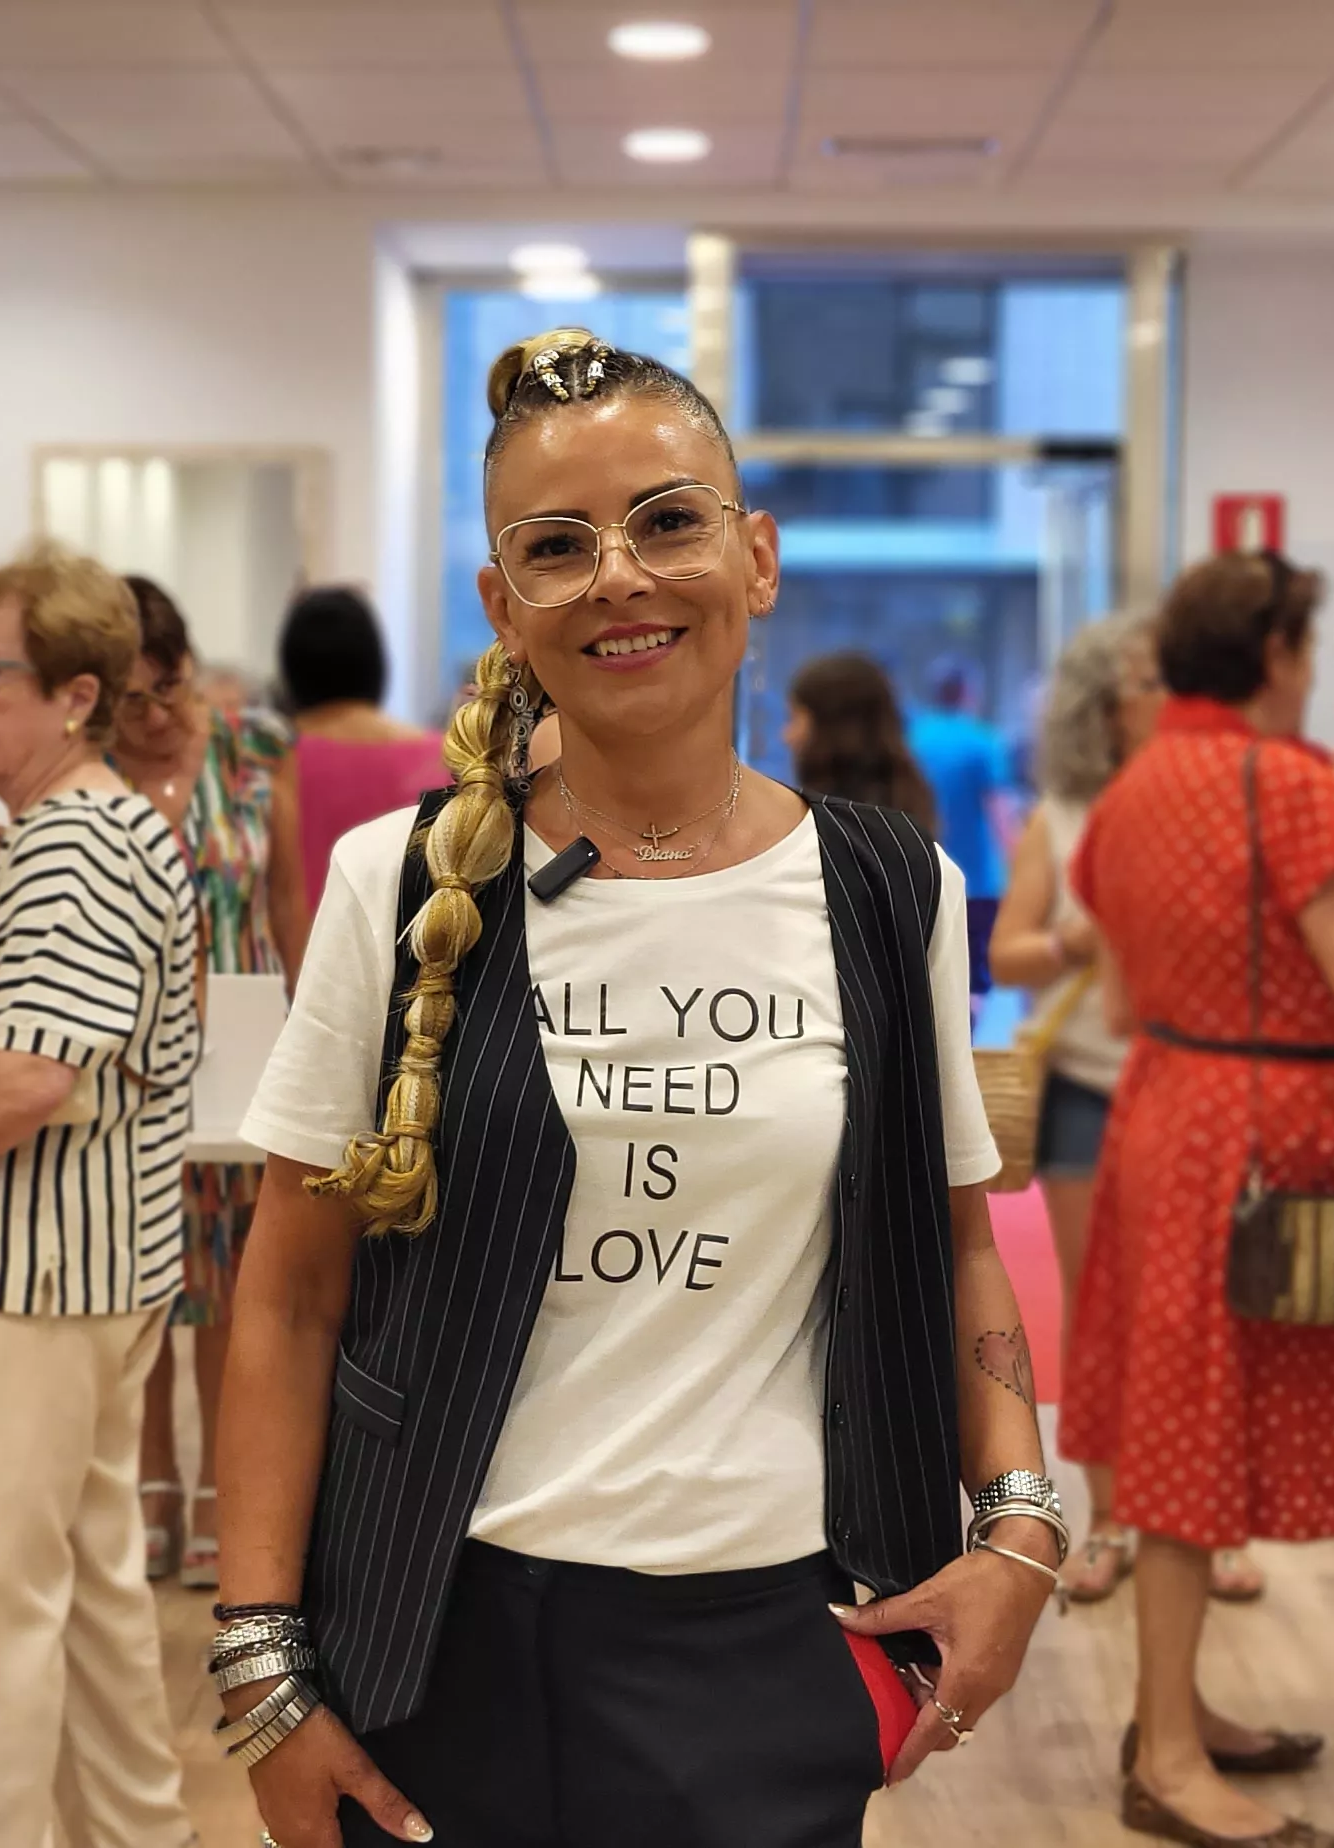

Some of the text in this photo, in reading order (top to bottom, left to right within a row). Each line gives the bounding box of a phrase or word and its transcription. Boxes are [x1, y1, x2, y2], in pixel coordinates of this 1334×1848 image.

[637, 845, 692, 861] Diana
[661, 986, 804, 1042] YOU
[576, 1058, 740, 1115] NEED
[624, 1142, 678, 1200] IS
[555, 1228, 729, 1291] LOVE
